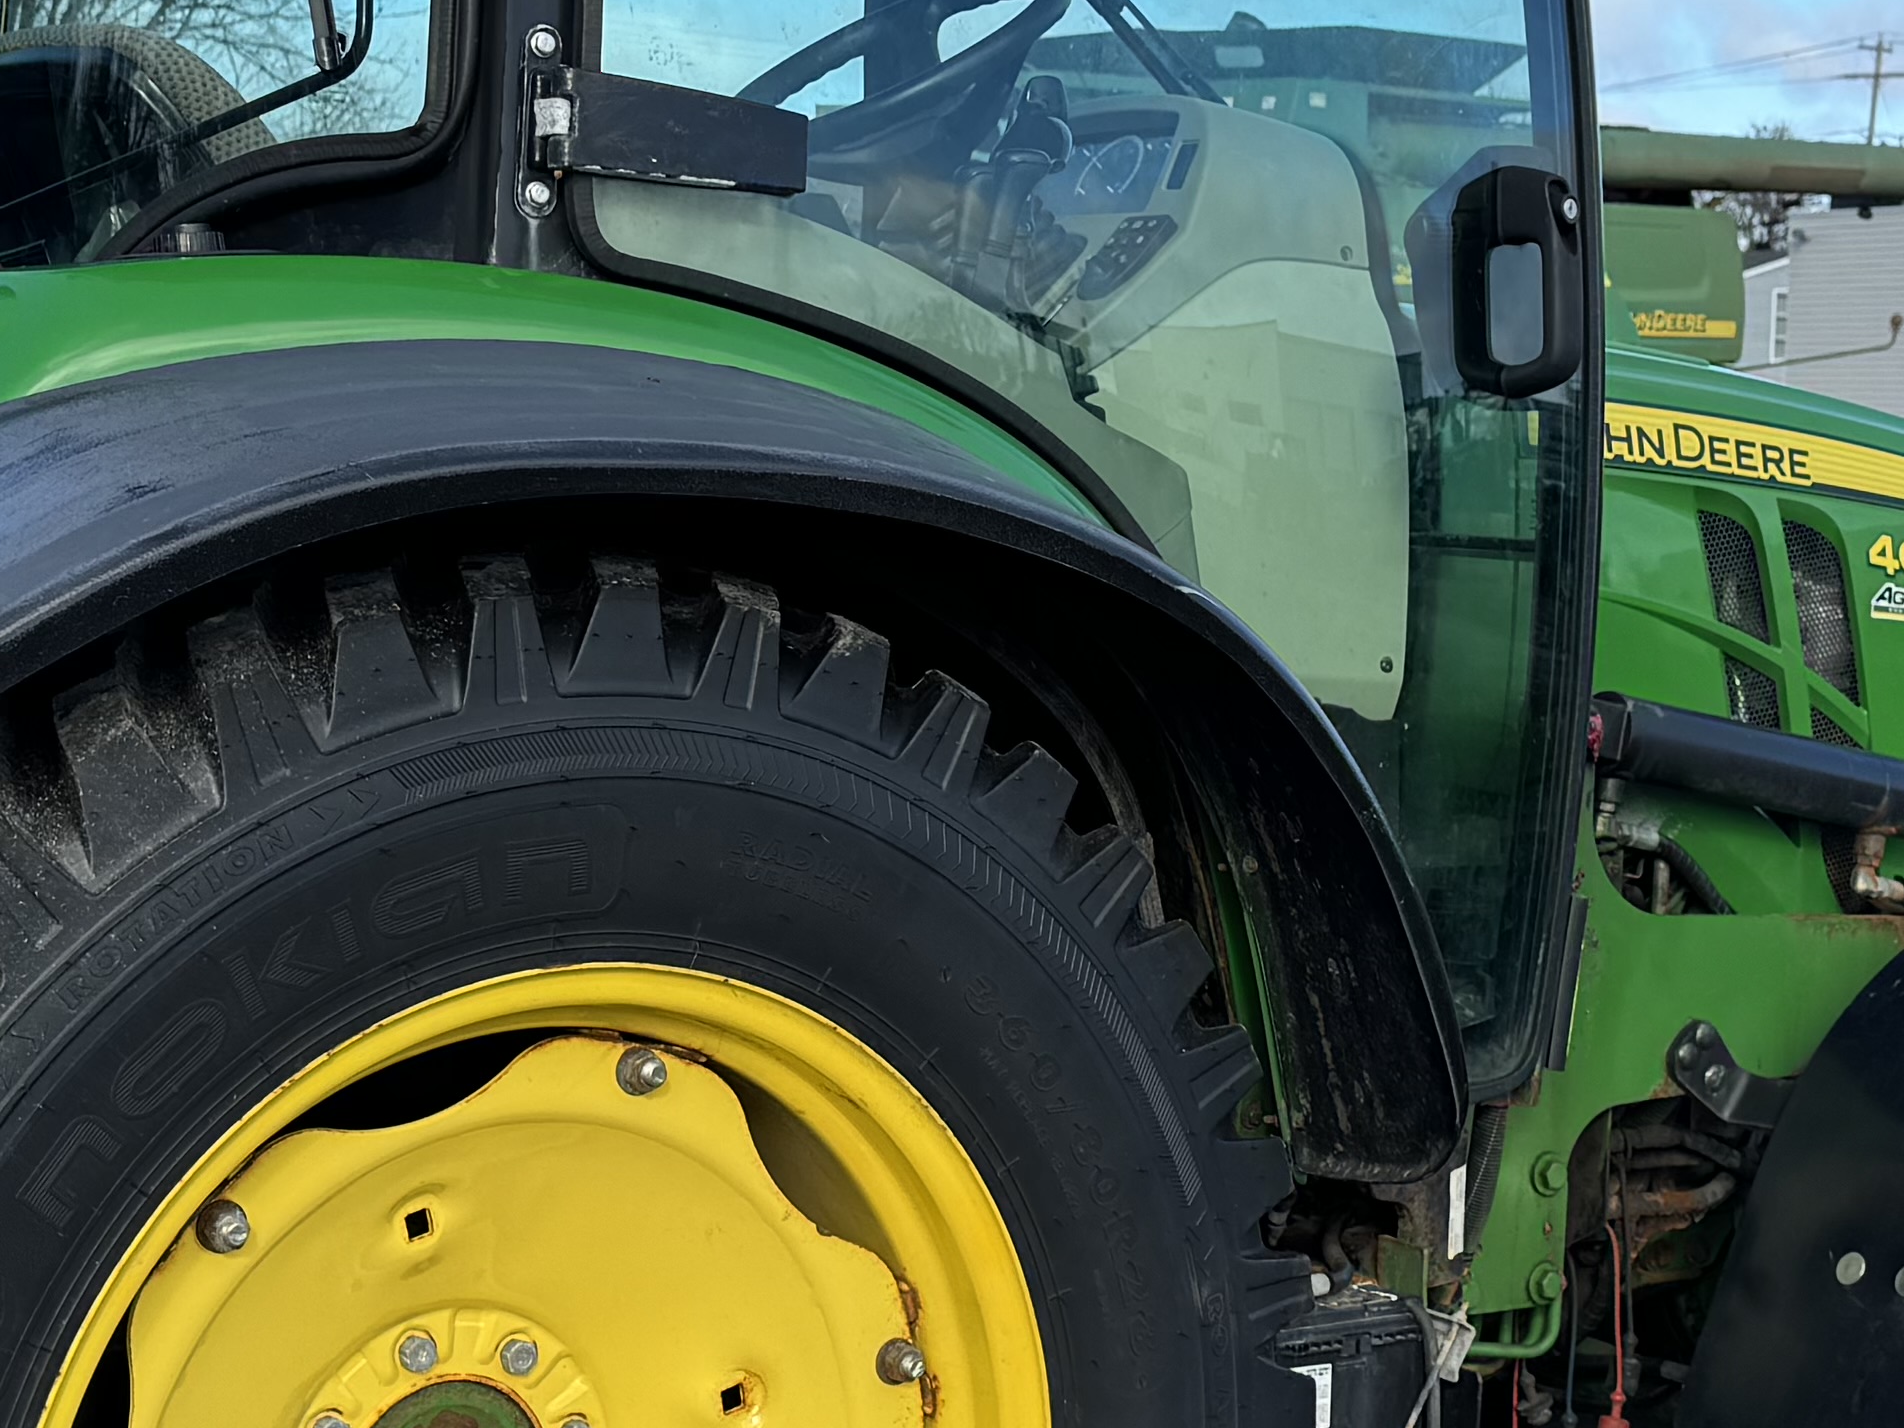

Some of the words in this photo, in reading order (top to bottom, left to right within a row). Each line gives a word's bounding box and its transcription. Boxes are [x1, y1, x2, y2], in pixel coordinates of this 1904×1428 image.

[1604, 422, 1666, 461] HN
[1672, 422, 1812, 480] DEERE
[53, 822, 296, 1015] ROTATION
